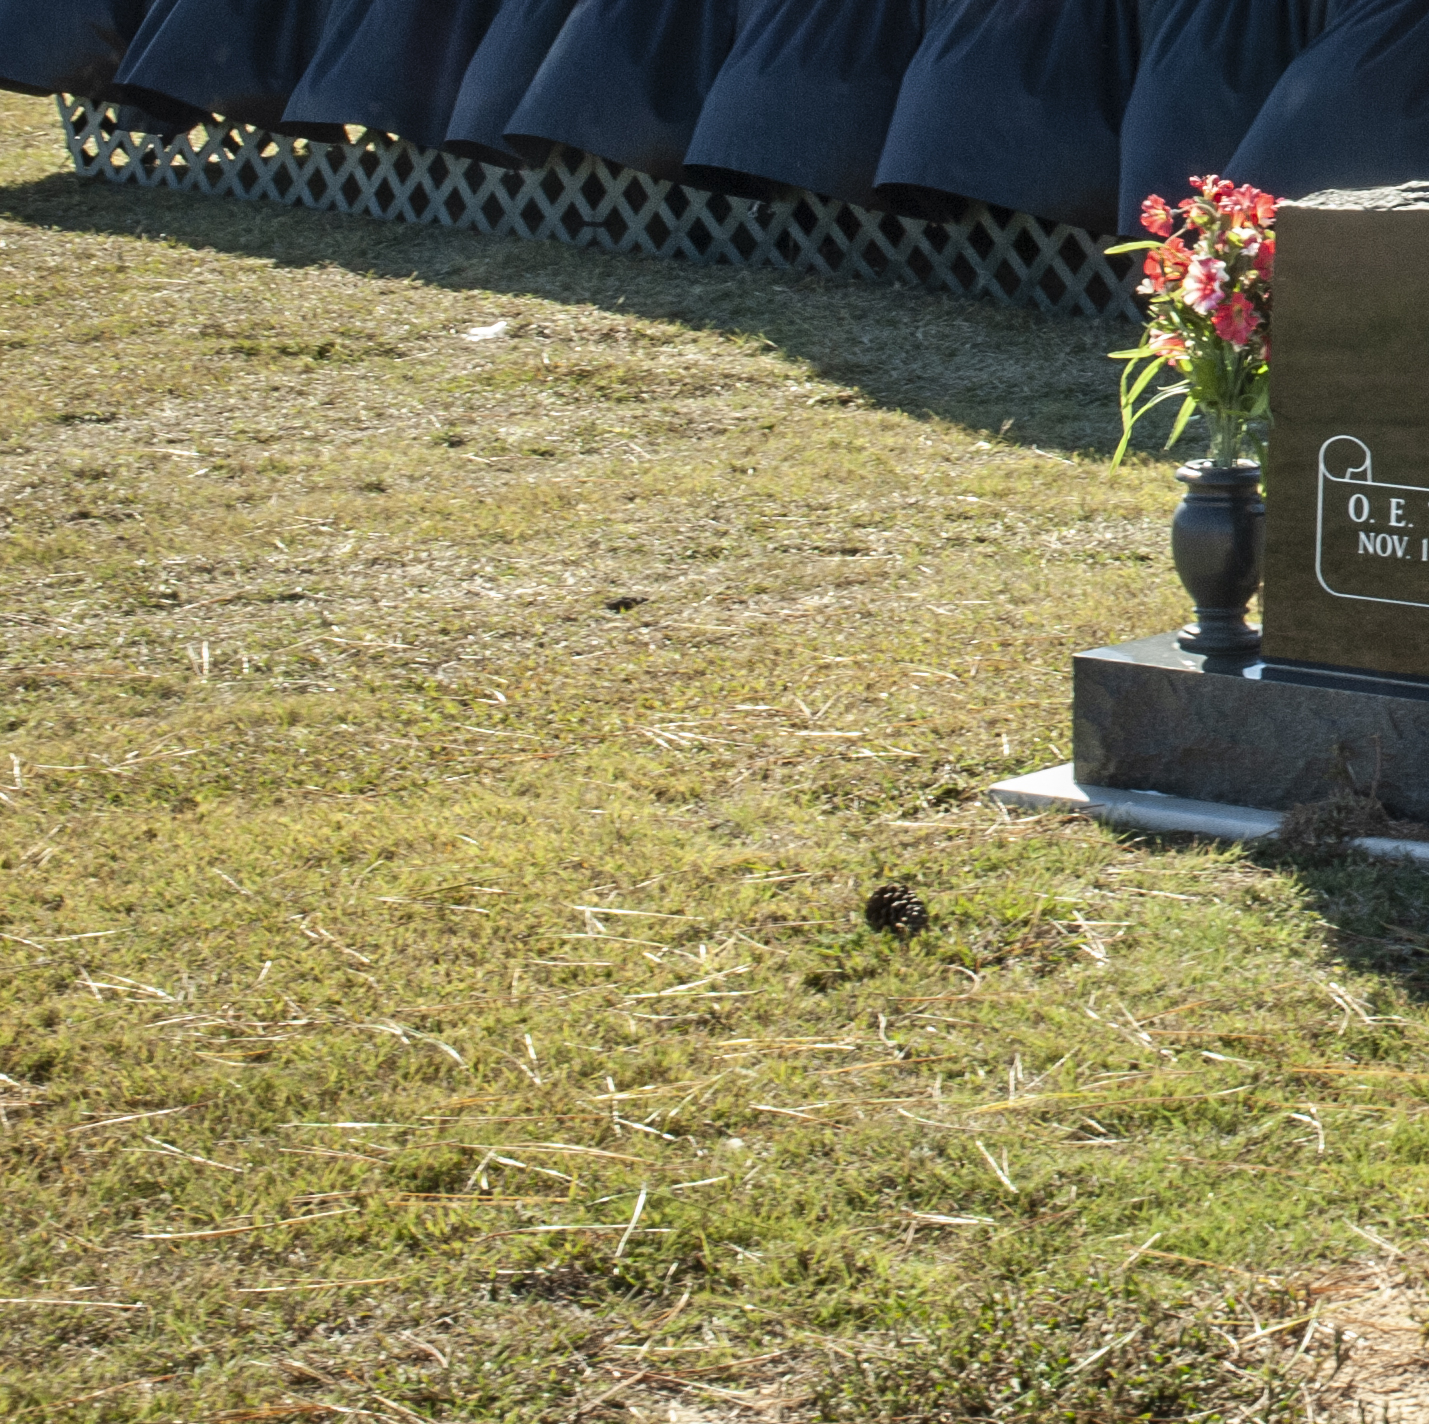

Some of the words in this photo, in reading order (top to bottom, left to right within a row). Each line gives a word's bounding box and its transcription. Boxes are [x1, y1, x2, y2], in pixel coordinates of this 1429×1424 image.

[1348, 493, 1375, 523] O.
[1389, 498, 1414, 527] E.
[1358, 531, 1411, 559] NOV.
